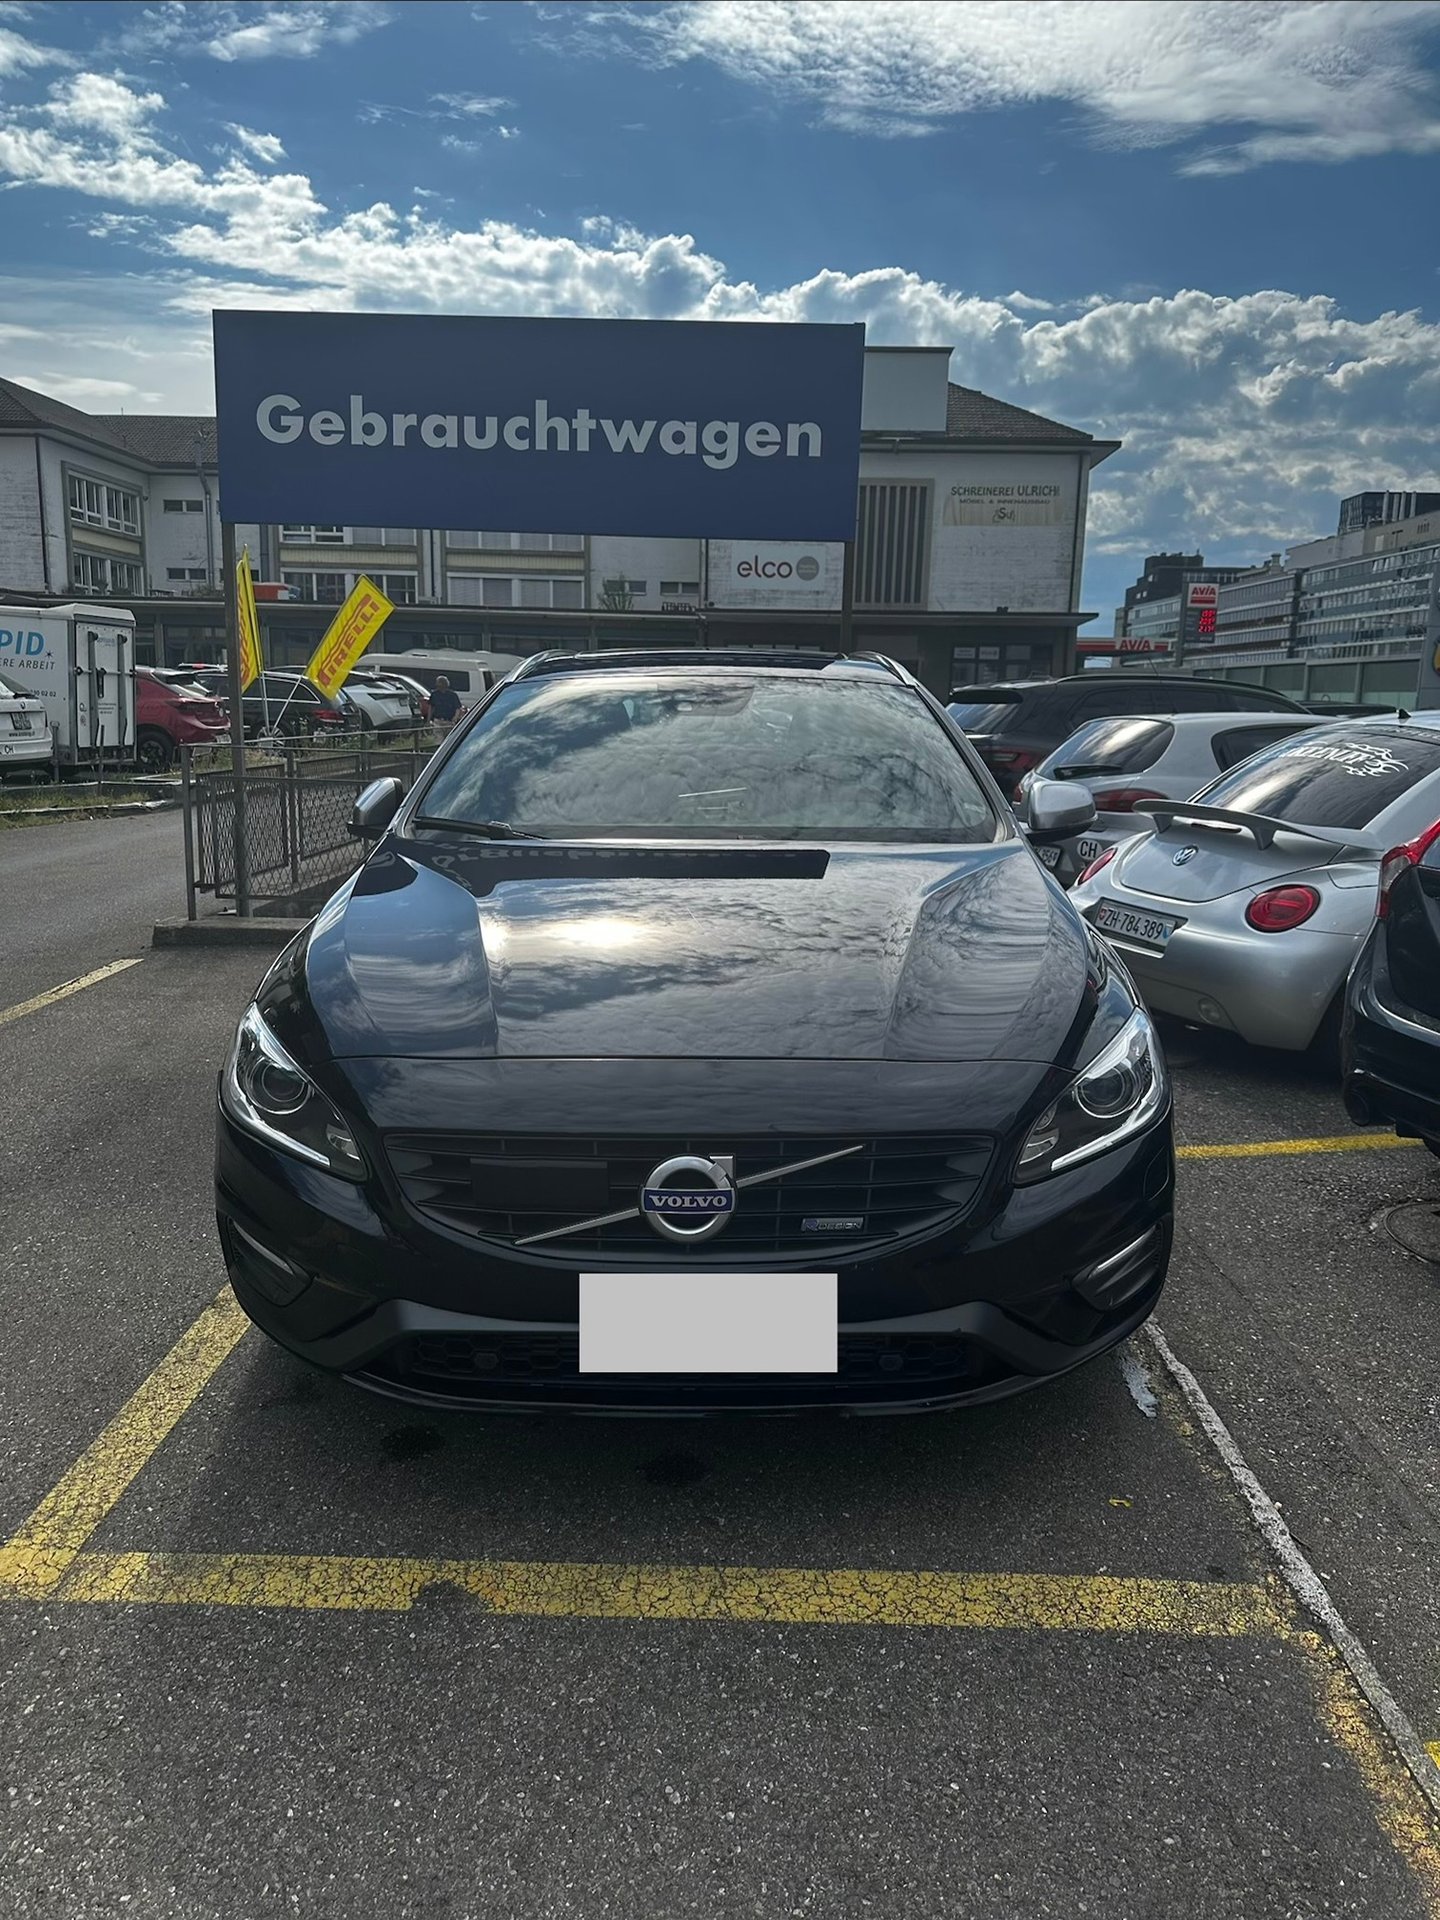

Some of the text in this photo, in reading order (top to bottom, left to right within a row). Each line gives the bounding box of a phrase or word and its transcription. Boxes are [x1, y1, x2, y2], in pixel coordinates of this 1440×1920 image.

[256, 393, 823, 470] Gebrauchtwagen
[950, 485, 1014, 497] SCHREINEREI
[737, 555, 793, 578] elco
[1191, 585, 1217, 596] AVIA
[317, 593, 380, 689] PIRELLI
[1120, 639, 1152, 650] AVIA
[18, 659, 55, 670] ARBEIT
[1080, 840, 1098, 858] CH
[649, 1195, 727, 1208] VOLVO
